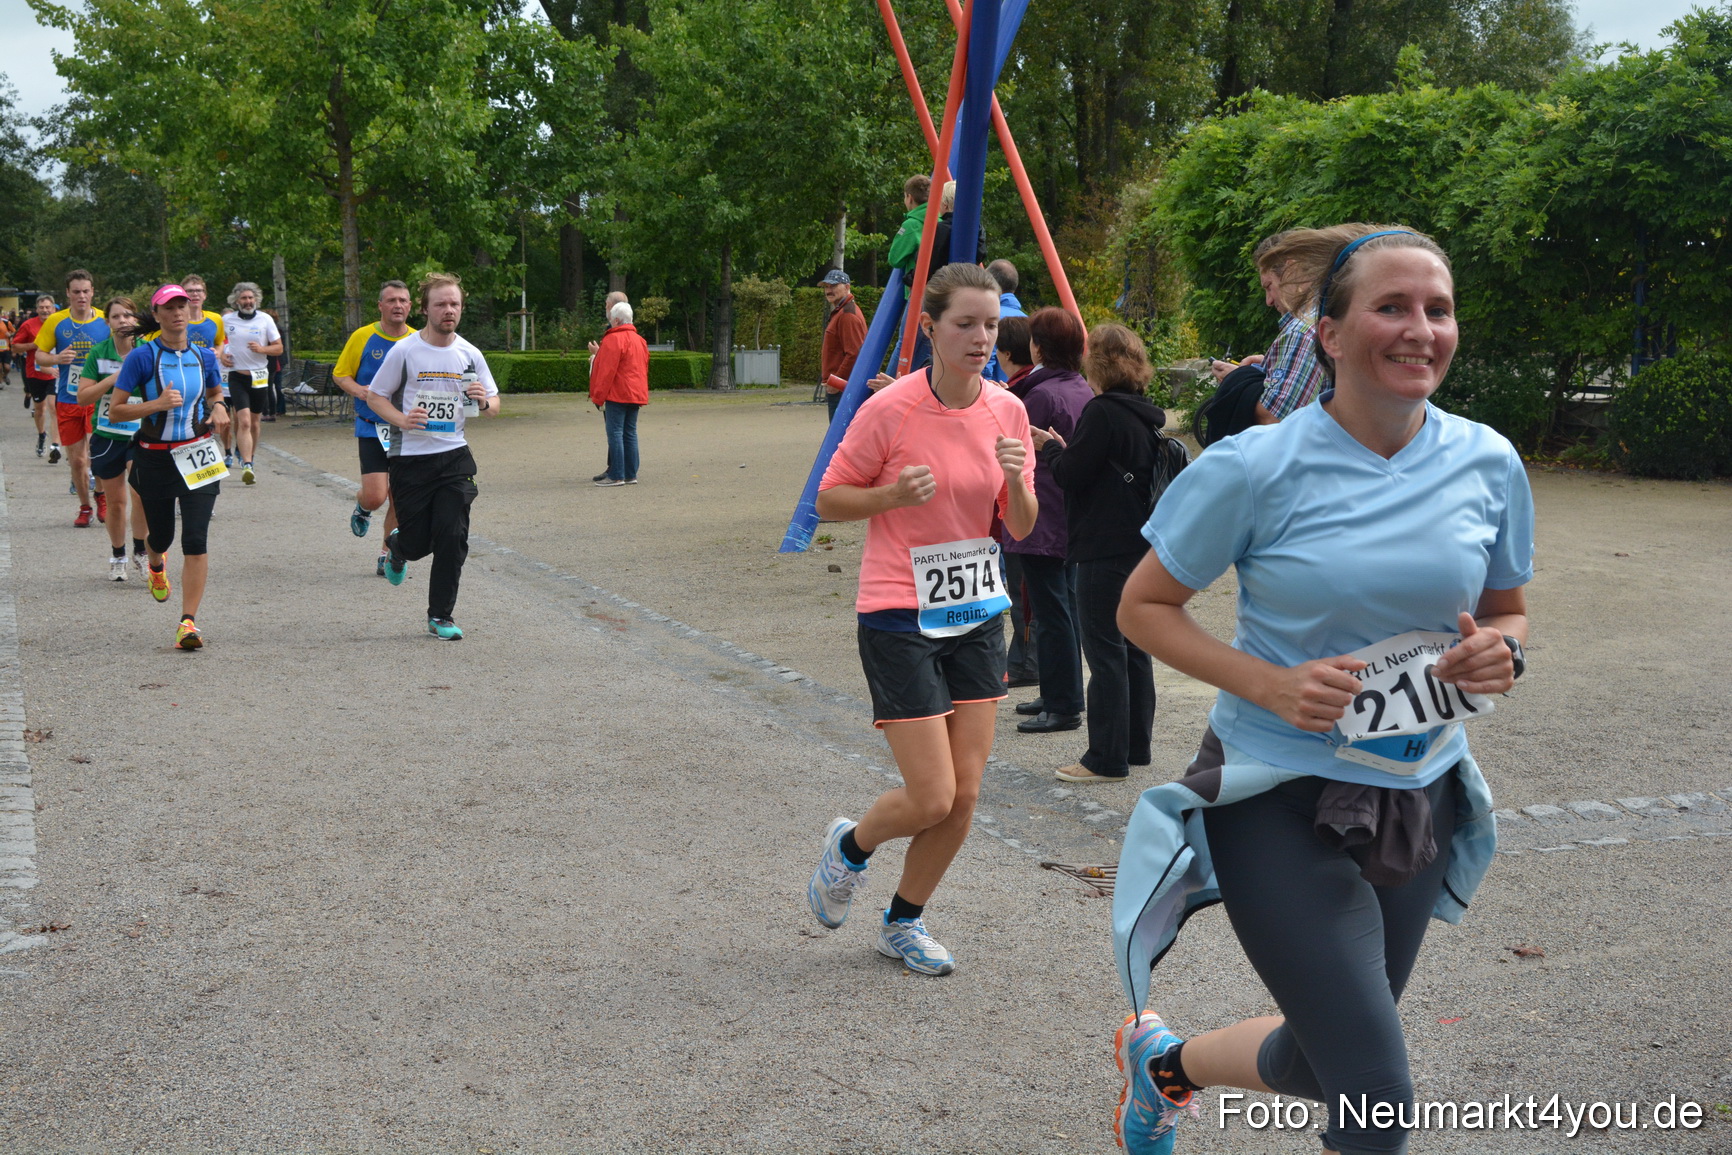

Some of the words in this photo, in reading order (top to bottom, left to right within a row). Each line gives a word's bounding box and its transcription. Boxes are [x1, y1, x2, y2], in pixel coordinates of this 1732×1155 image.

[186, 446, 216, 469] 125
[914, 553, 948, 565] PARTL
[949, 547, 986, 560] Neumarkt
[925, 559, 995, 603] 2574
[946, 606, 989, 624] Regina
[1350, 662, 1384, 681] RTL
[1384, 642, 1445, 669] Neumarkt
